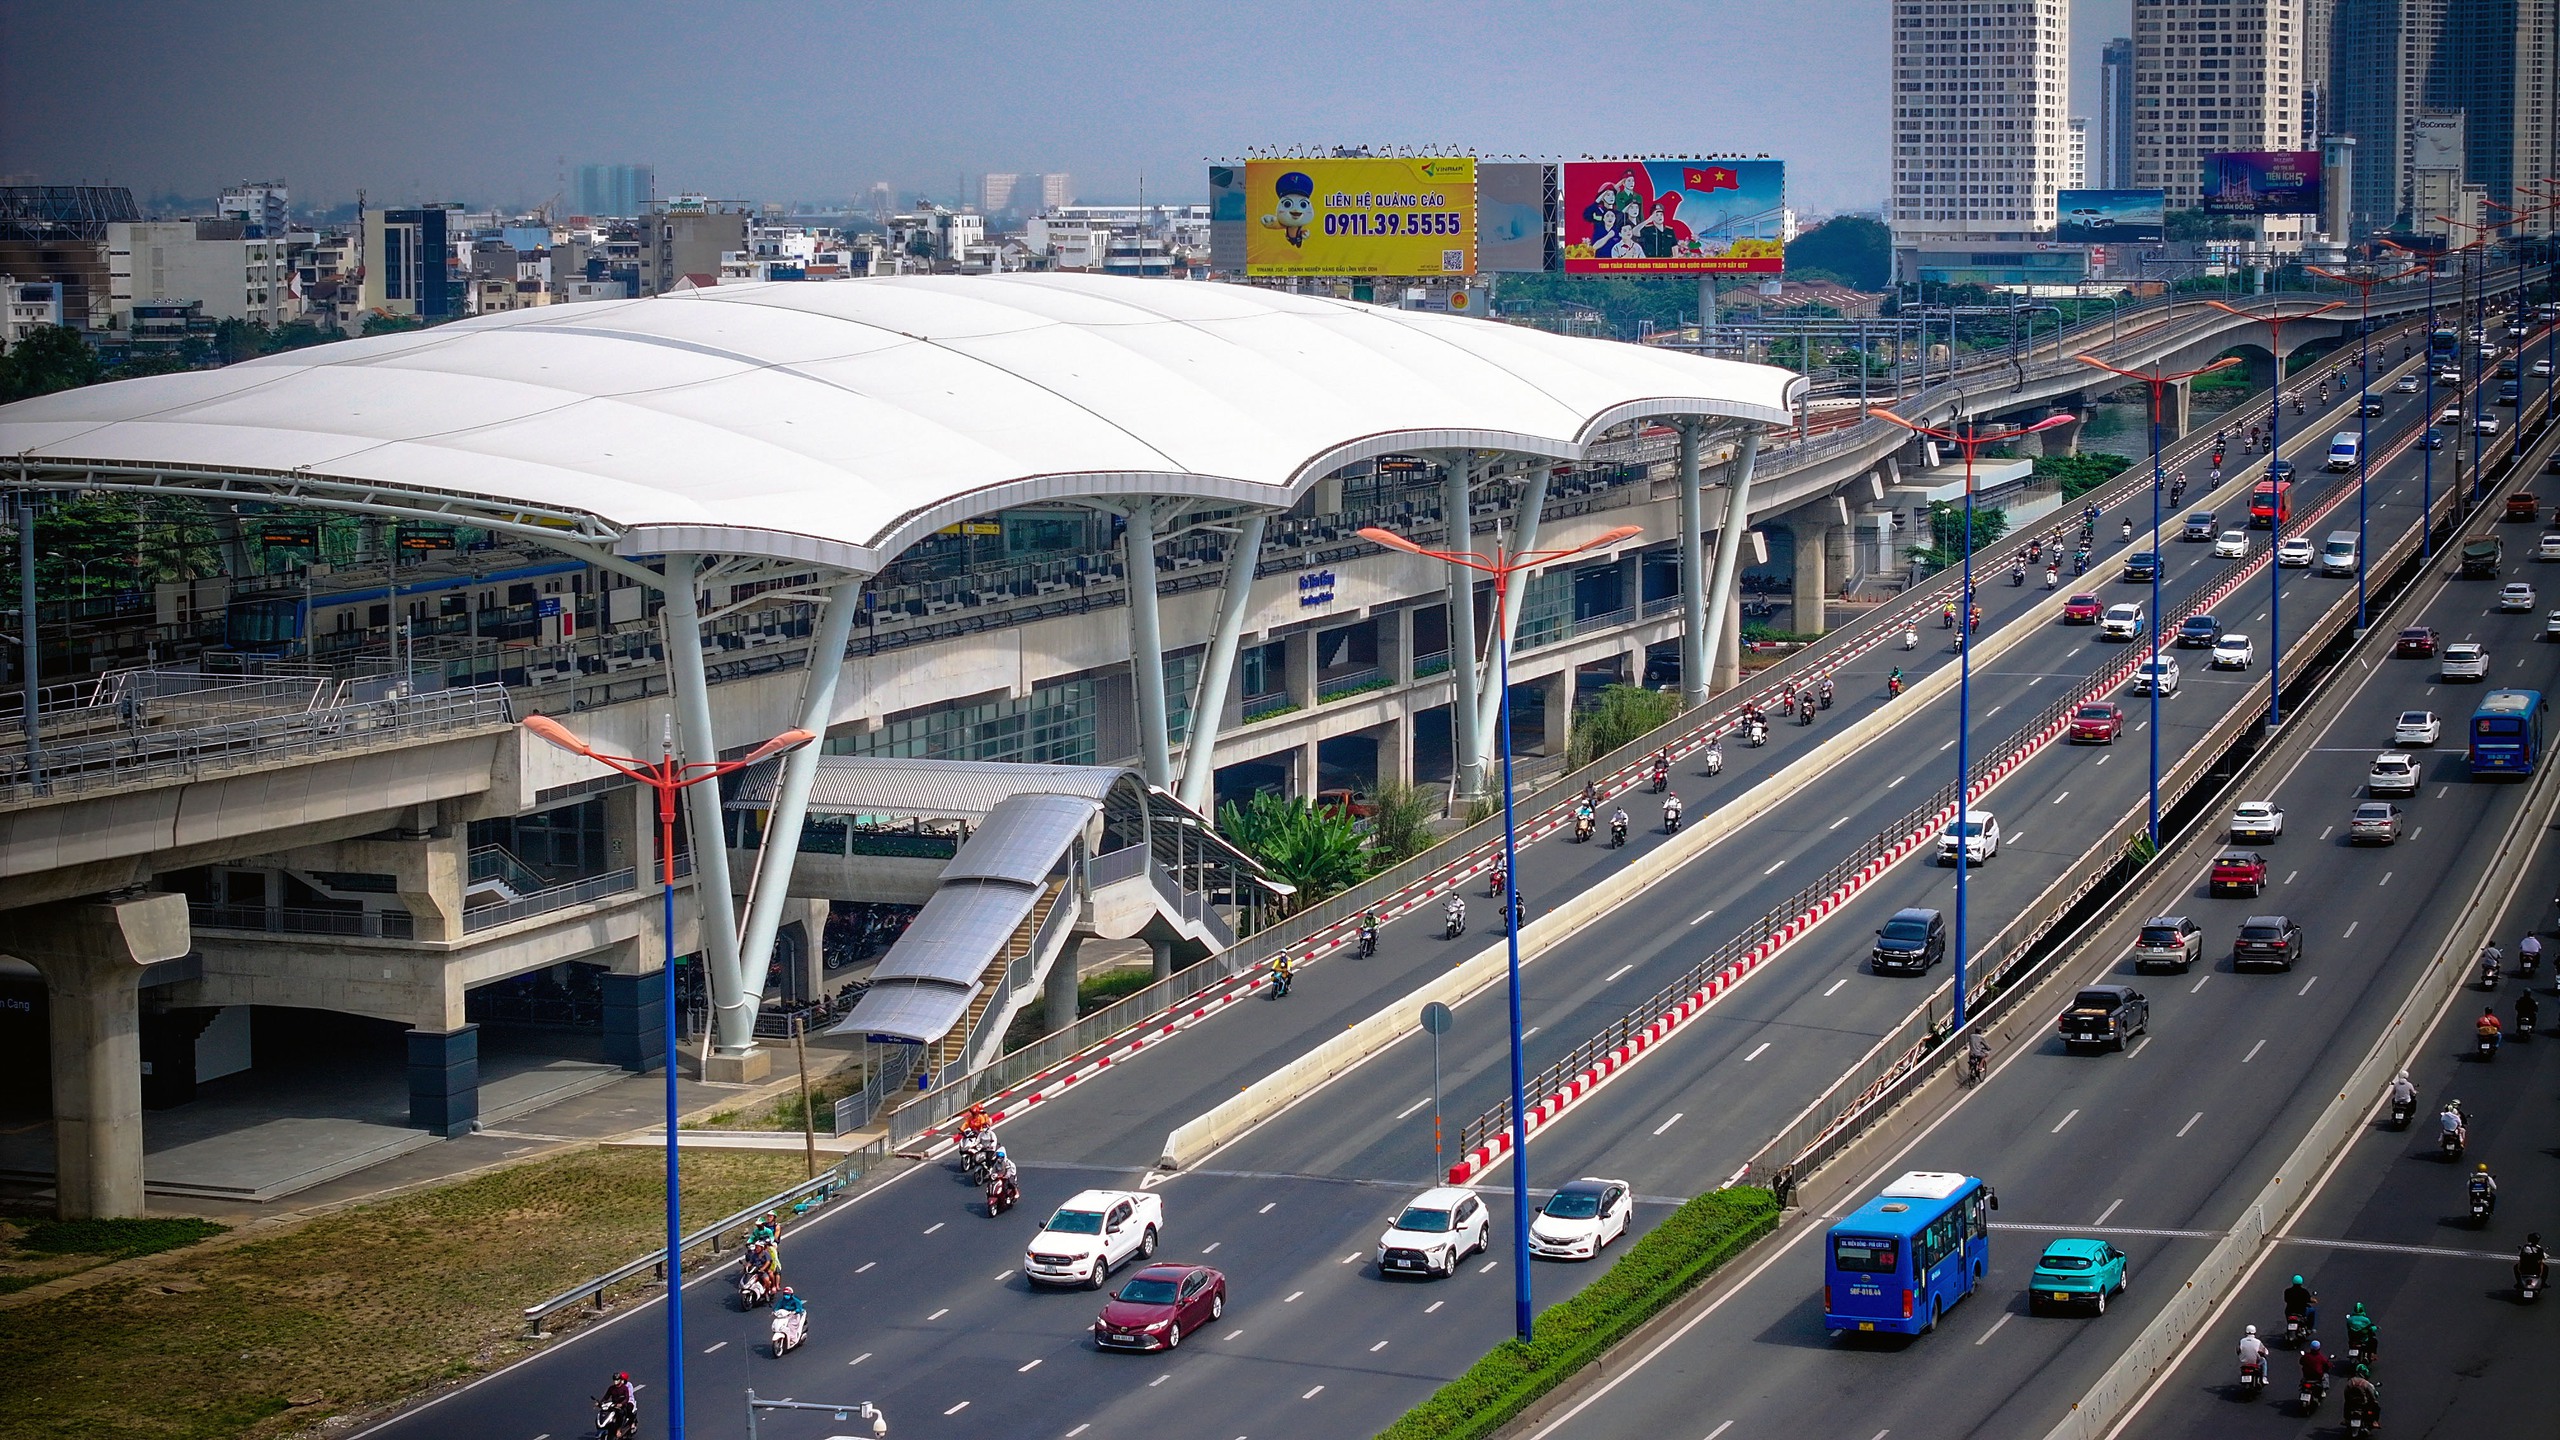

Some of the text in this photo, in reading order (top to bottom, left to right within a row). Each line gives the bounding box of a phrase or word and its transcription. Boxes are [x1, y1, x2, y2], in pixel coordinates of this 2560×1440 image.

[2420, 121, 2457, 129] BoConcept
[2282, 170, 2294, 181] ÍCH
[1325, 191, 1444, 210] LIÊN HỆ QUẢNG CÁO
[1324, 213, 1461, 235] 0911.39.5555
[7, 998, 30, 1012] Cang
